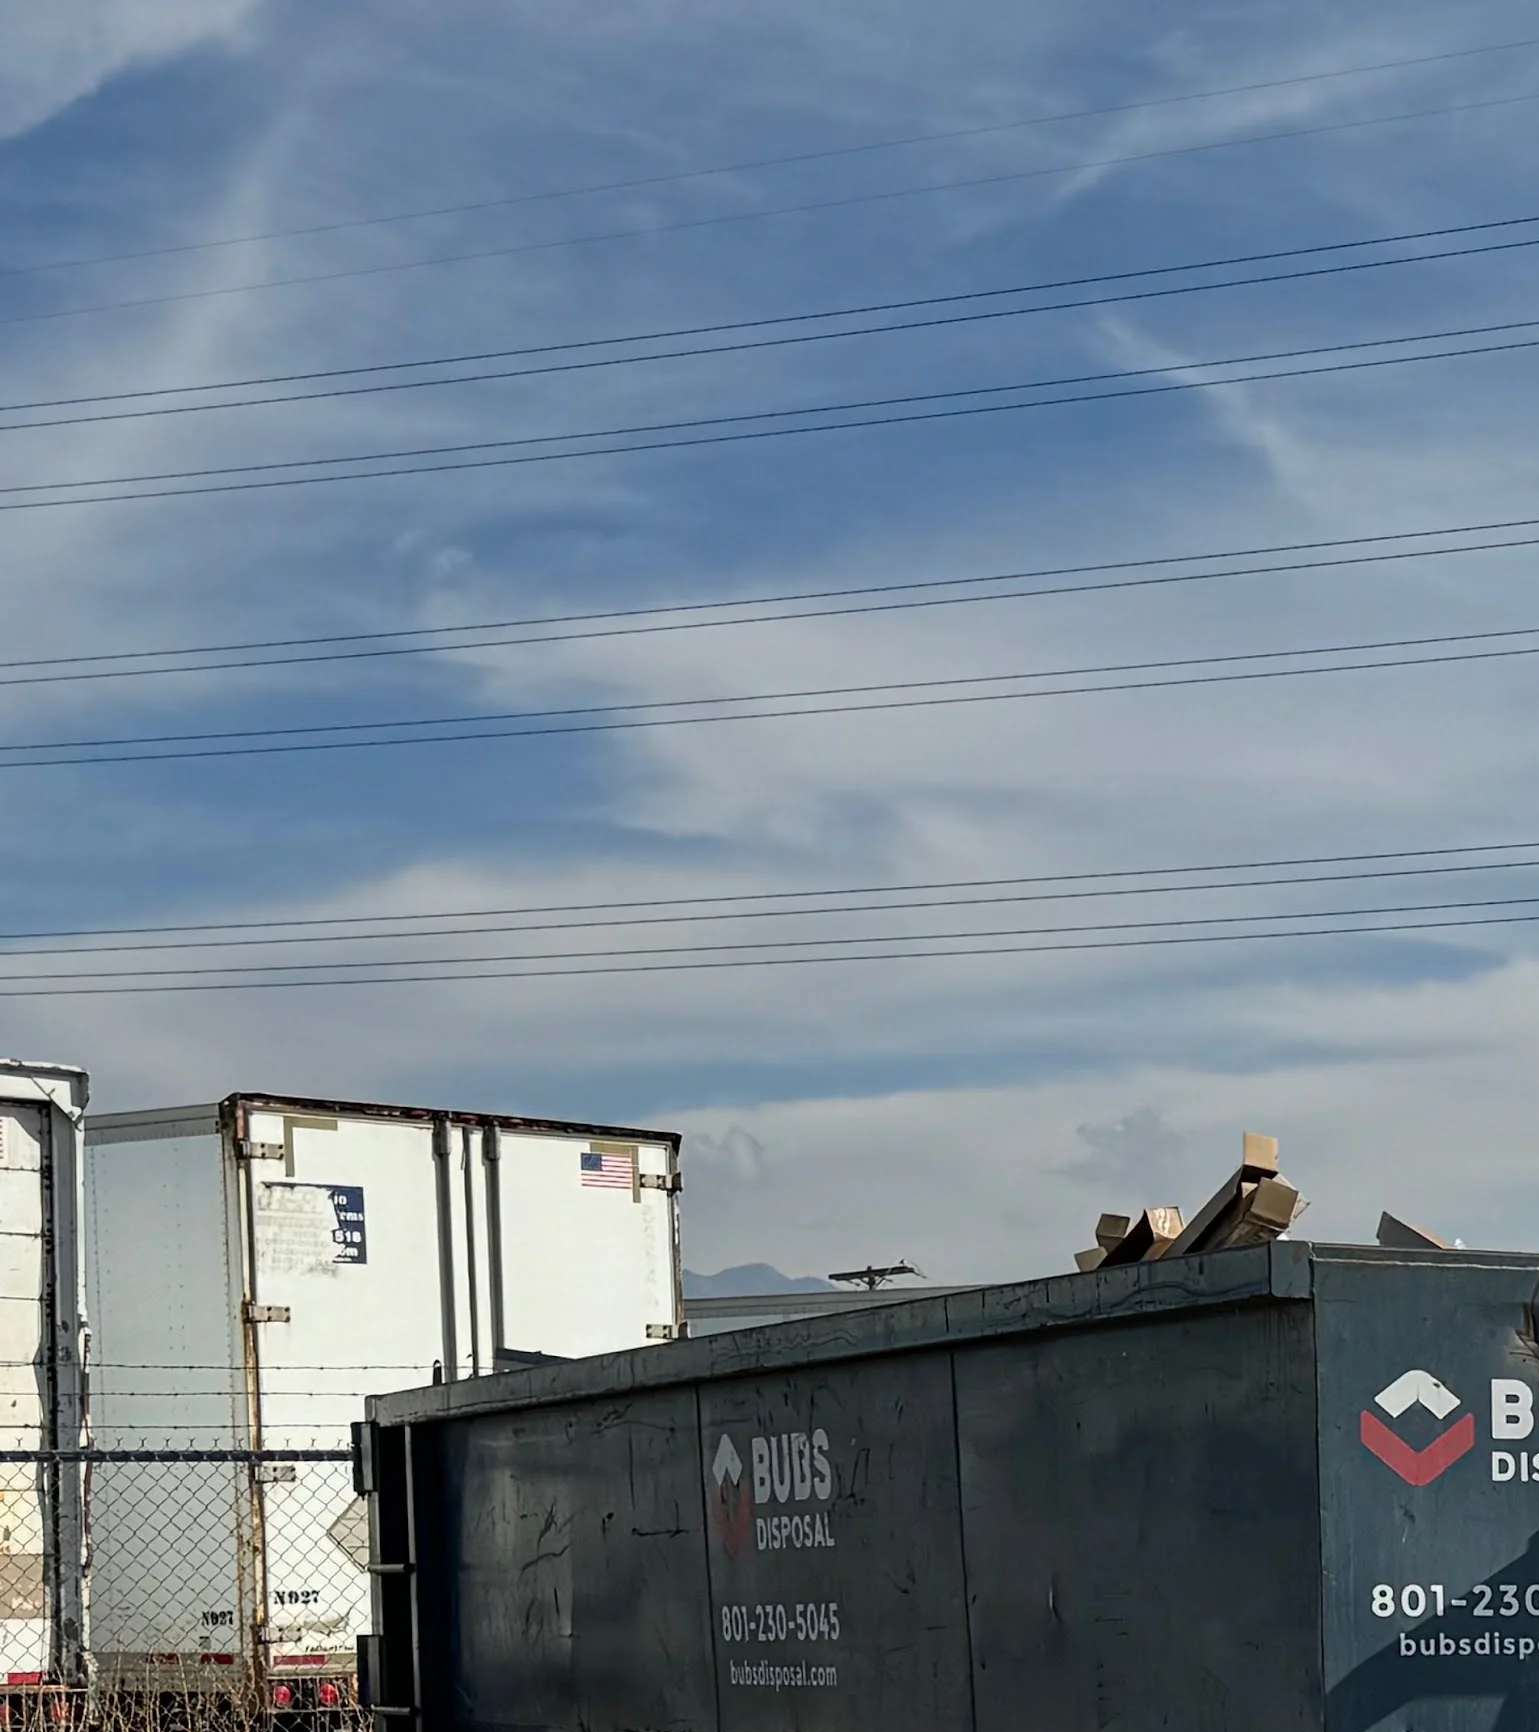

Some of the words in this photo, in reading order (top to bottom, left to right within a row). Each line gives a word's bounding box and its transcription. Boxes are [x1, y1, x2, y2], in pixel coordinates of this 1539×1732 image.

[752, 1428, 832, 1503] BUBS
[756, 1512, 835, 1550] DISPOSAL
[722, 1603, 840, 1642] 801-230-5045
[730, 1659, 837, 1692] bubsdisposal.com
